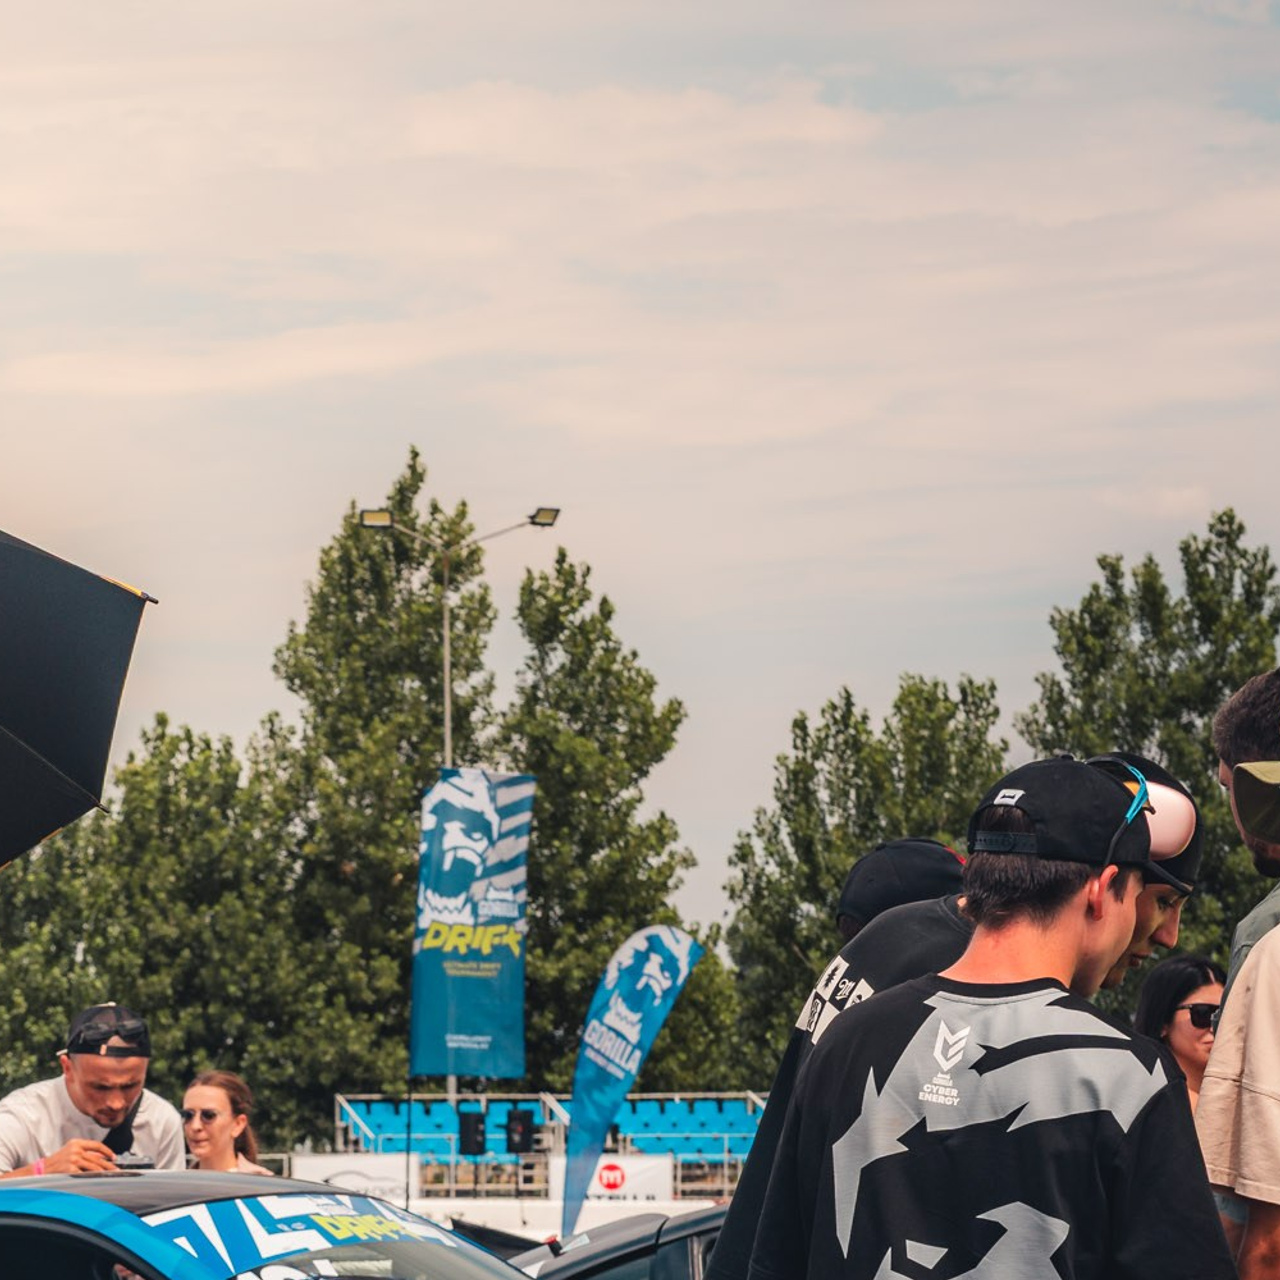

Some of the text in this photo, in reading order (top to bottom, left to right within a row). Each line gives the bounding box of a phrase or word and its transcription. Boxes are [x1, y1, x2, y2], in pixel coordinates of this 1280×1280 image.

[422, 920, 523, 959] DRIFT
[923, 1083, 959, 1097] CYBER
[918, 1091, 961, 1106] ENERGY
